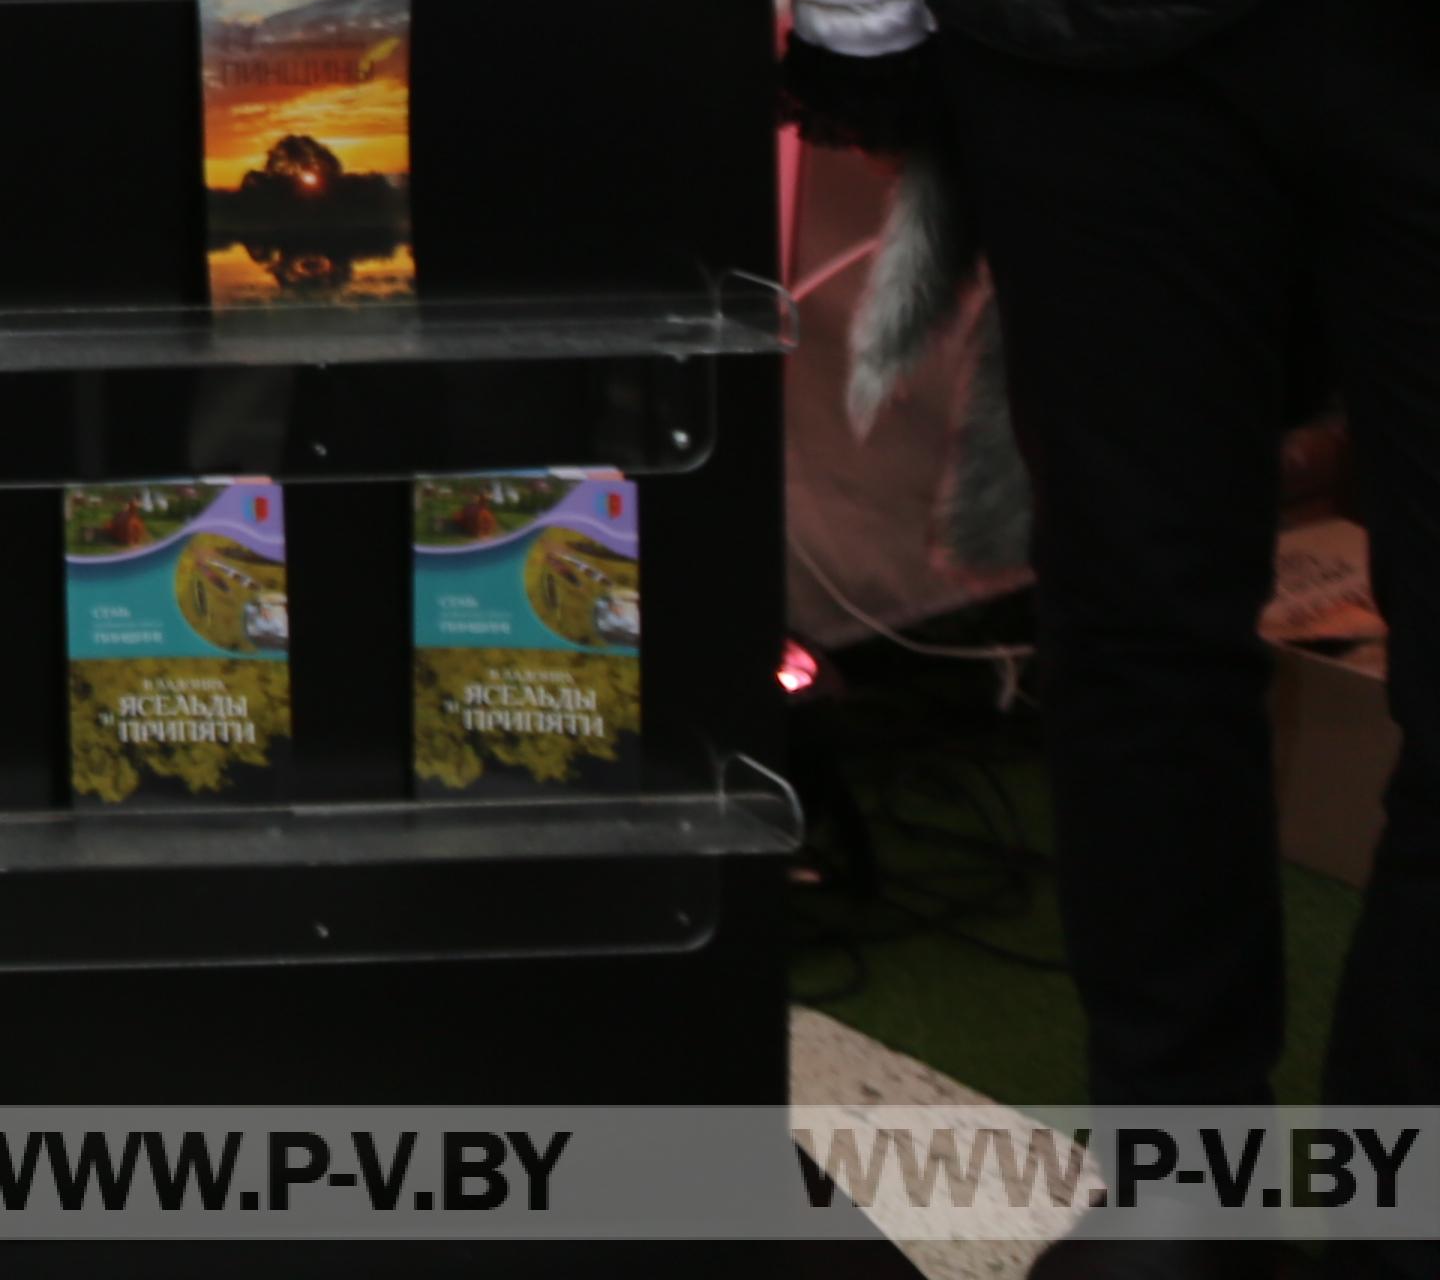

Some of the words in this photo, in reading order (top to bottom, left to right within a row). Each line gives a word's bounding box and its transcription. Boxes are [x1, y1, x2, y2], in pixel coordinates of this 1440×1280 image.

[119, 694, 248, 719] ЯСЕЛЬДЫ
[463, 684, 597, 711] ЯСЕЛЬДЫ
[118, 719, 256, 744] ПРИПЯТИ
[462, 709, 605, 738] ПРИПЯТИ
